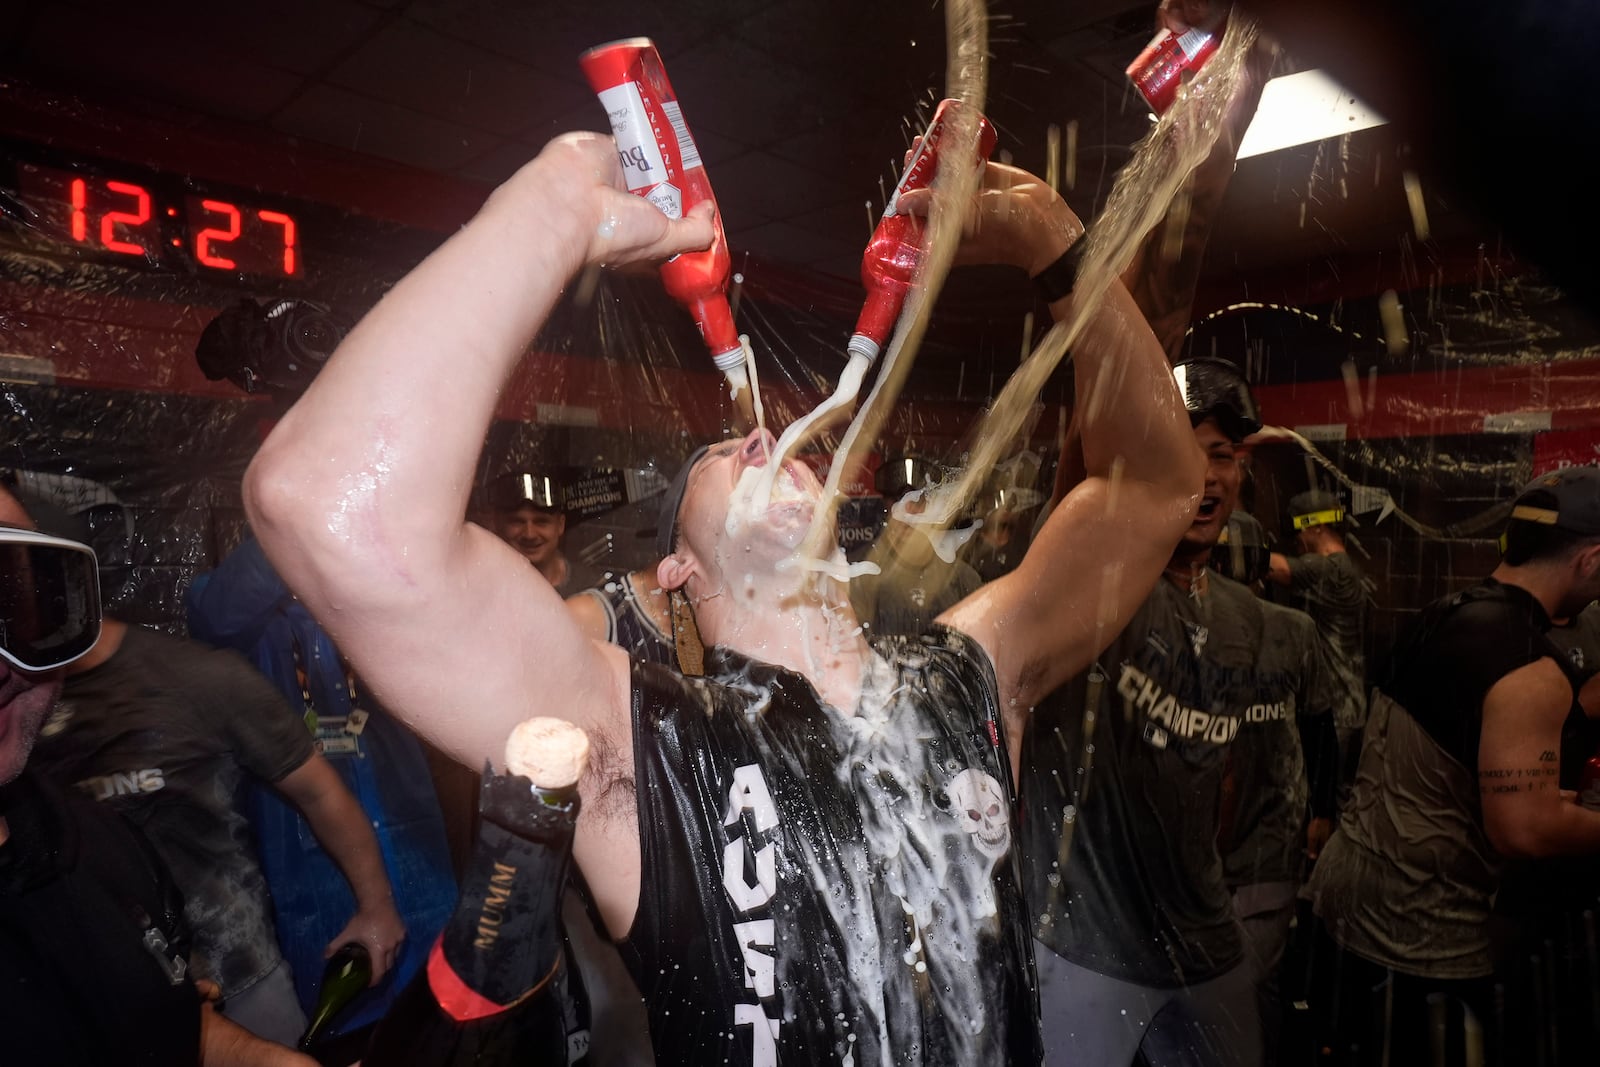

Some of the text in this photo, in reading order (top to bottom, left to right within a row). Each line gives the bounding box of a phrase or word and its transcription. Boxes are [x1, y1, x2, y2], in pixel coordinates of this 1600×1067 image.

[636, 80, 675, 180] GENUINE
[71, 178, 296, 275] 12:27
[566, 491, 623, 511] CHAMPIONS
[473, 861, 517, 952] MUMM
